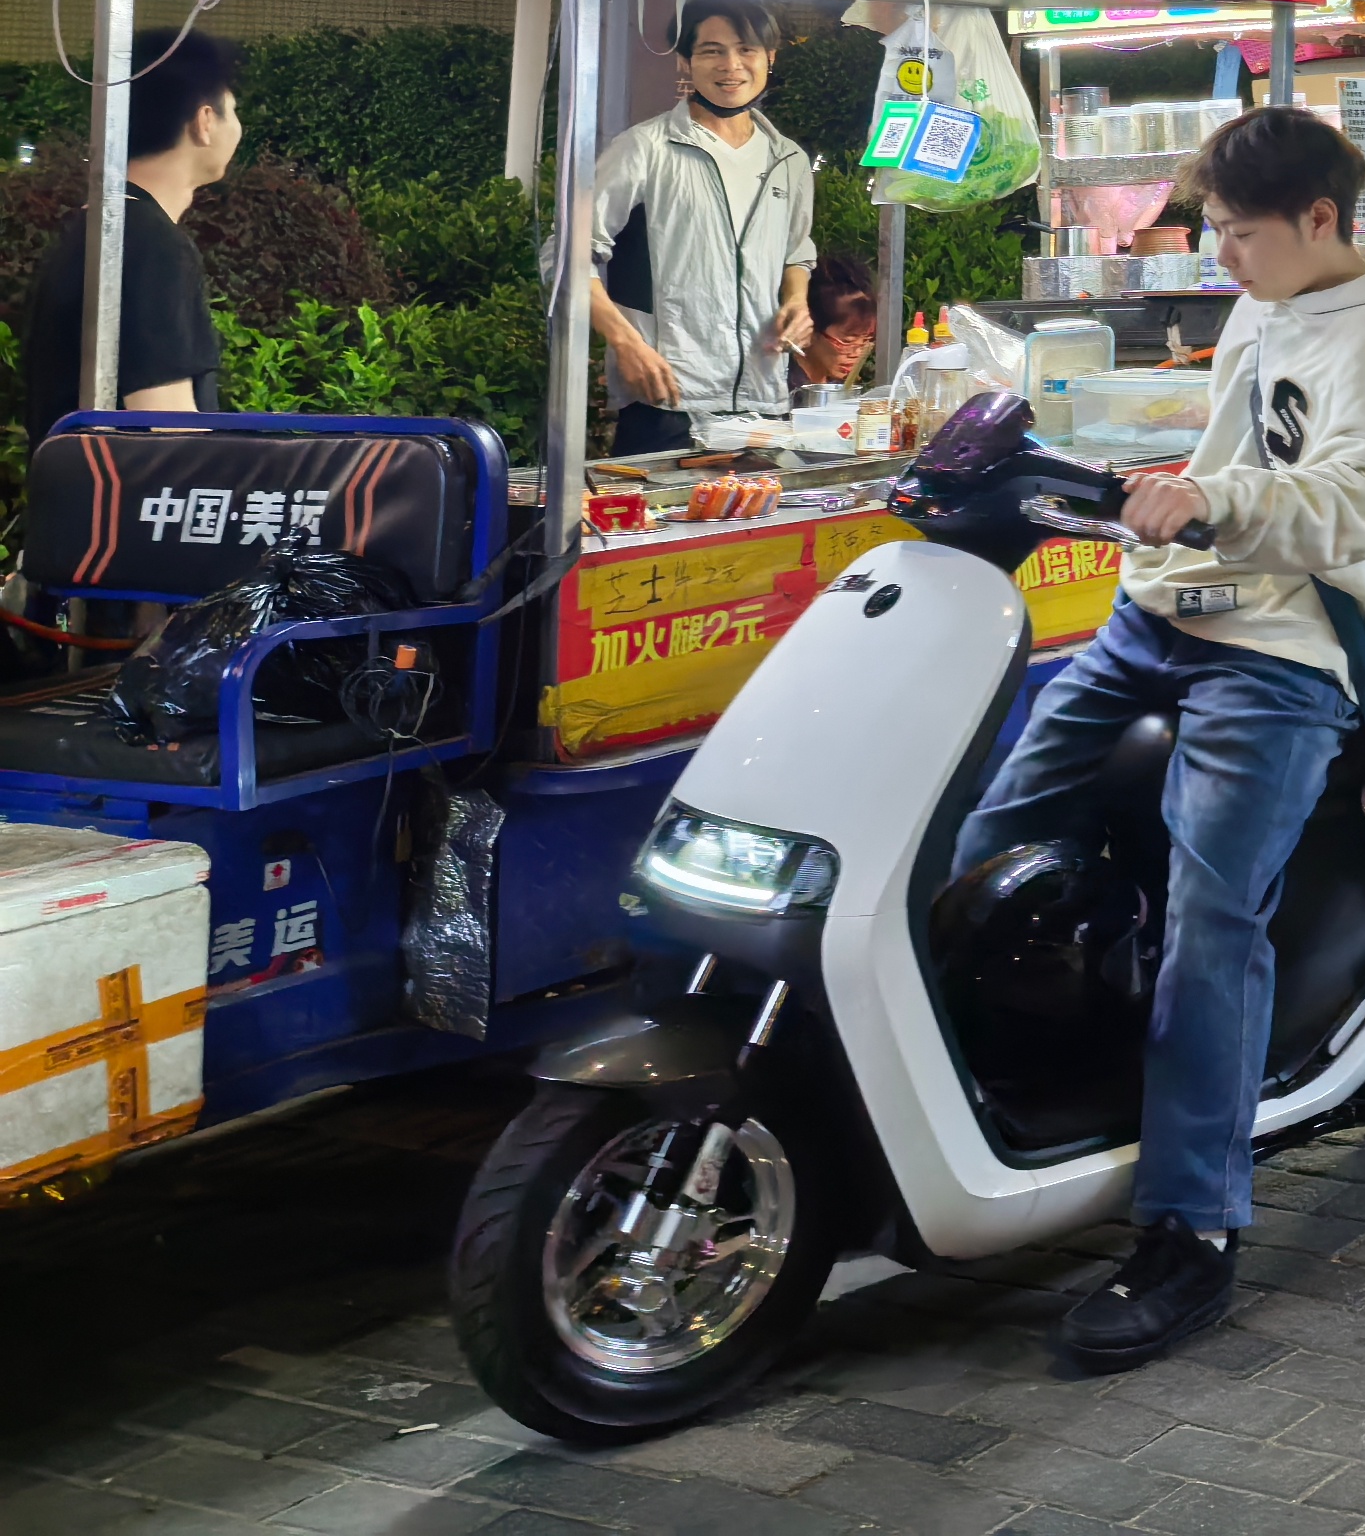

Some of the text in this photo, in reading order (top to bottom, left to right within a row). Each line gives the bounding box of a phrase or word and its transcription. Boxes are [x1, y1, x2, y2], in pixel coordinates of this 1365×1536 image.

[1265, 378, 1308, 465] S
[1015, 540, 1123, 591] 加培根2
[591, 603, 766, 676] 加火腿2元
